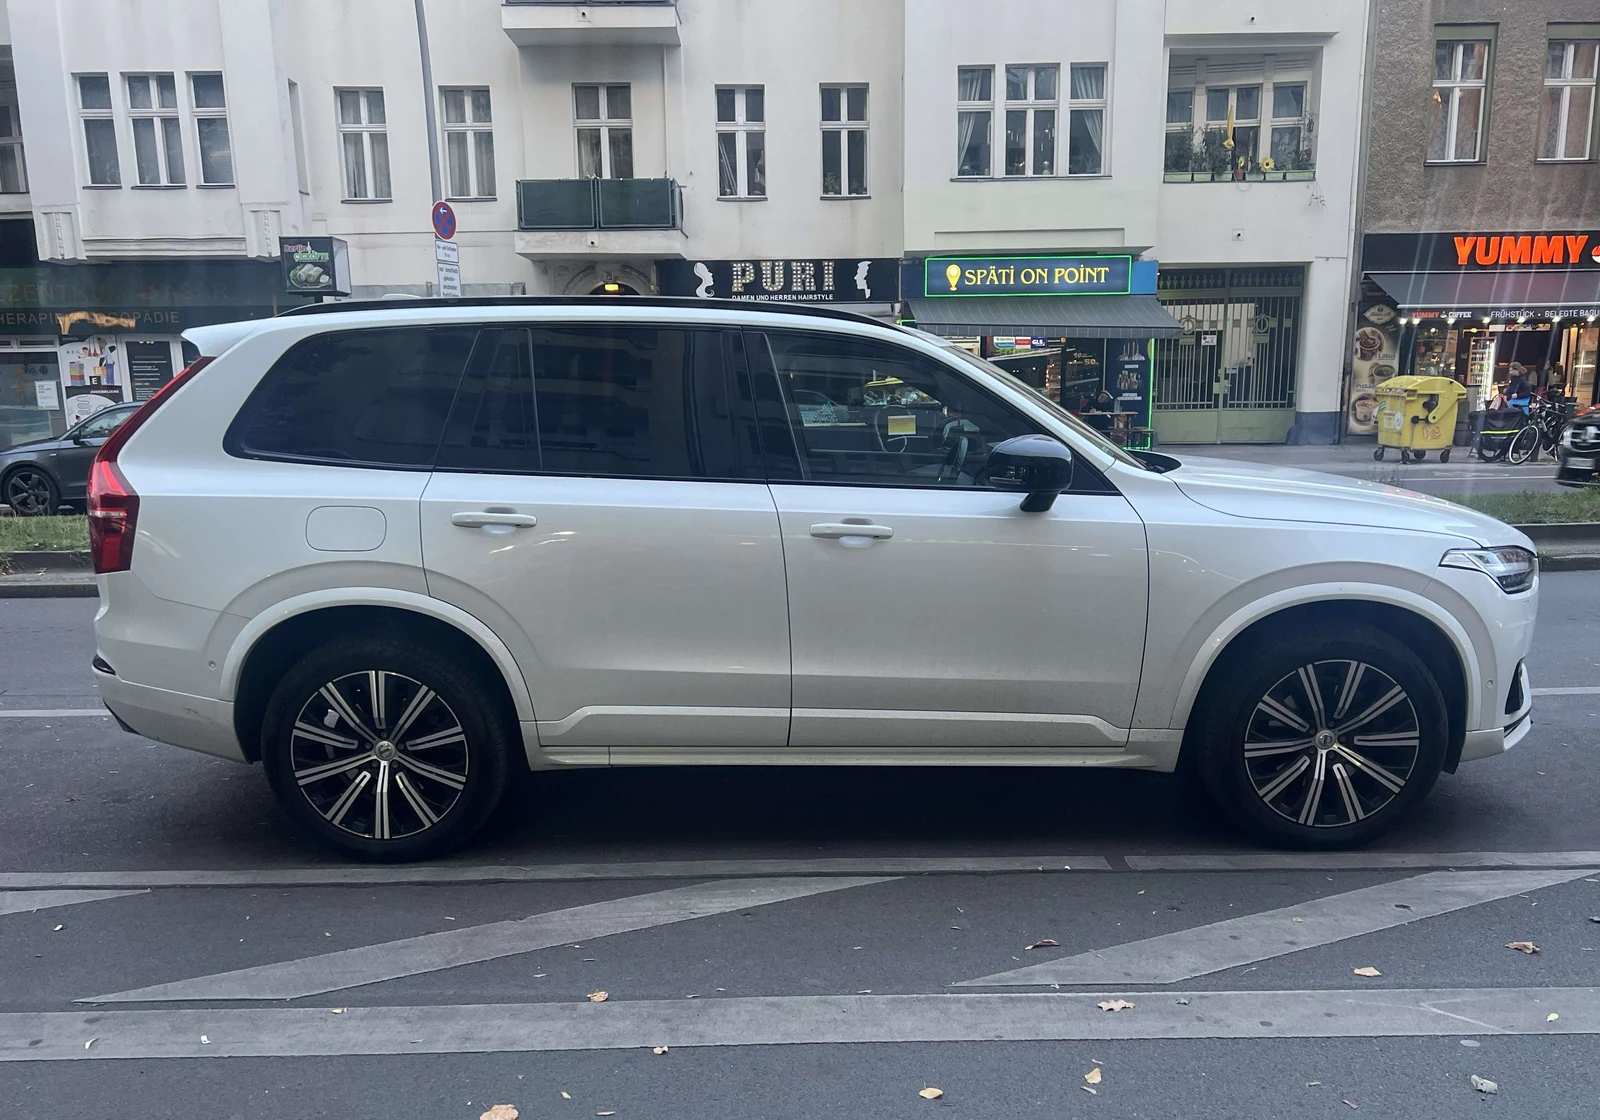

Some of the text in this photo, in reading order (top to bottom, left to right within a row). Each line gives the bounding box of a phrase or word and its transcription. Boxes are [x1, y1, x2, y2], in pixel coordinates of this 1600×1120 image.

[1454, 235, 1589, 265] YUMMY
[731, 261, 835, 292] PURI
[1020, 268, 1048, 284] ON
[1412, 311, 1439, 319] YUMMY
[1491, 309, 1535, 318] FRÜHSTÜCK
[1545, 310, 1578, 318] BELEGTE
[92, 377, 98, 385] E
